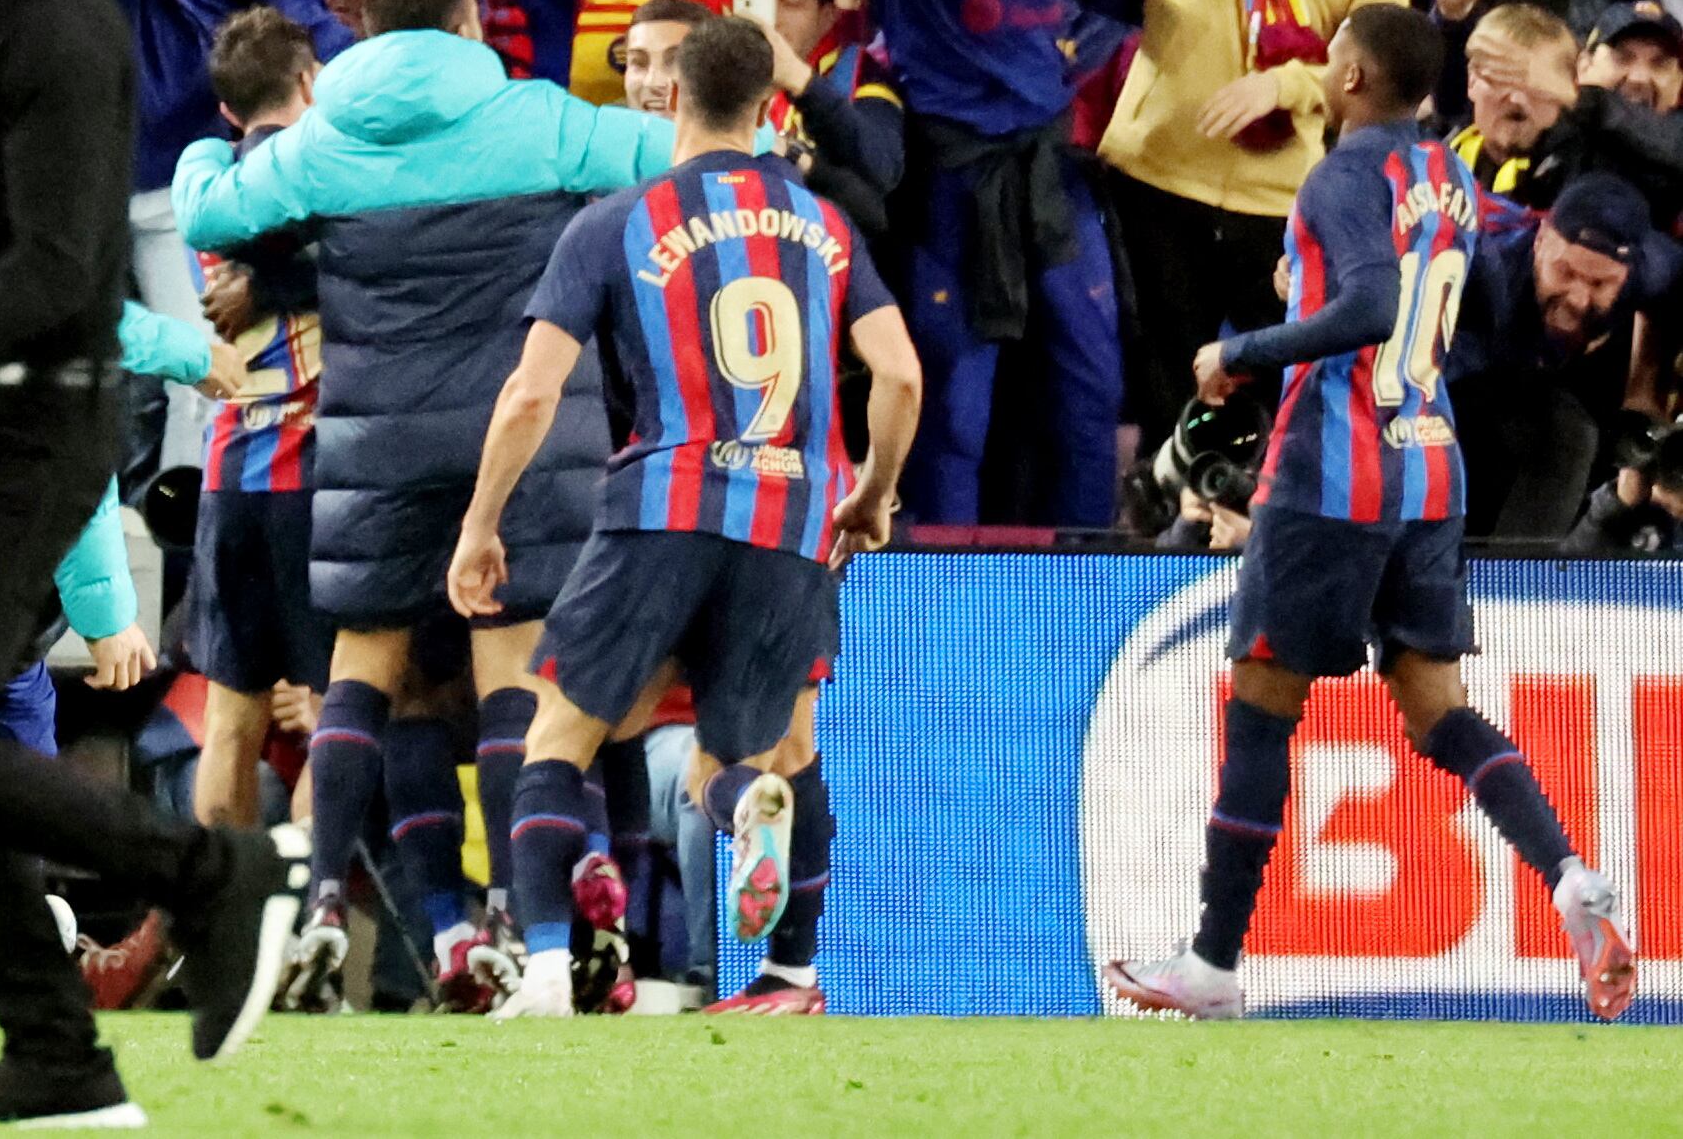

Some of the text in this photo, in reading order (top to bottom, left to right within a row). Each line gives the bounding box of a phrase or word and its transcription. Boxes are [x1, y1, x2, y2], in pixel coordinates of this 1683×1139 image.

[636, 208, 850, 288] LEWANDOWSKI
[709, 276, 803, 442] 9
[1371, 249, 1468, 407] 10
